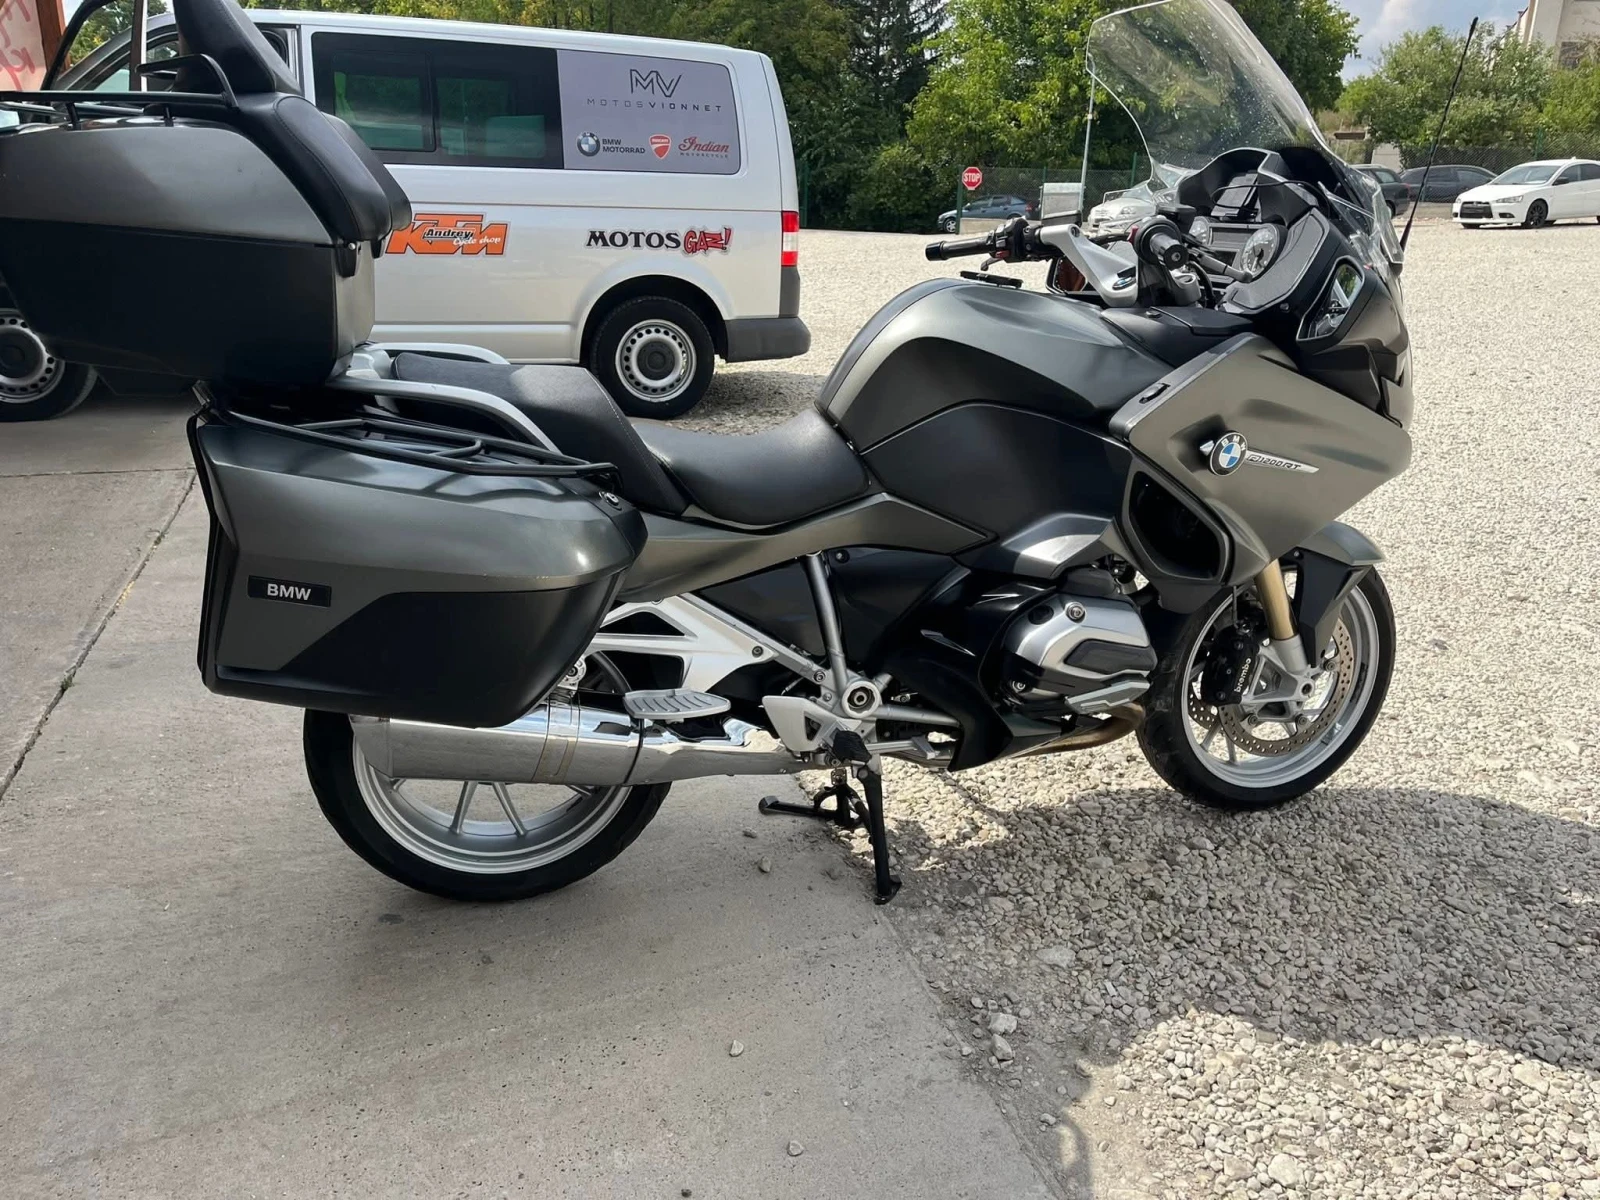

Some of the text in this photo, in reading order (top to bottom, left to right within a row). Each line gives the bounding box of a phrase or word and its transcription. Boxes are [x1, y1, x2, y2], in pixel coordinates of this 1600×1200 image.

[602, 146, 646, 154] MOTORRAD
[678, 136, 730, 153] Indian
[963, 172, 981, 183] STOP
[479, 235, 501, 244] shop
[586, 230, 681, 248] MOTOS
[1220, 434, 1246, 451] BMW
[267, 583, 311, 601] BMW
[1233, 657, 1252, 693] brembo
